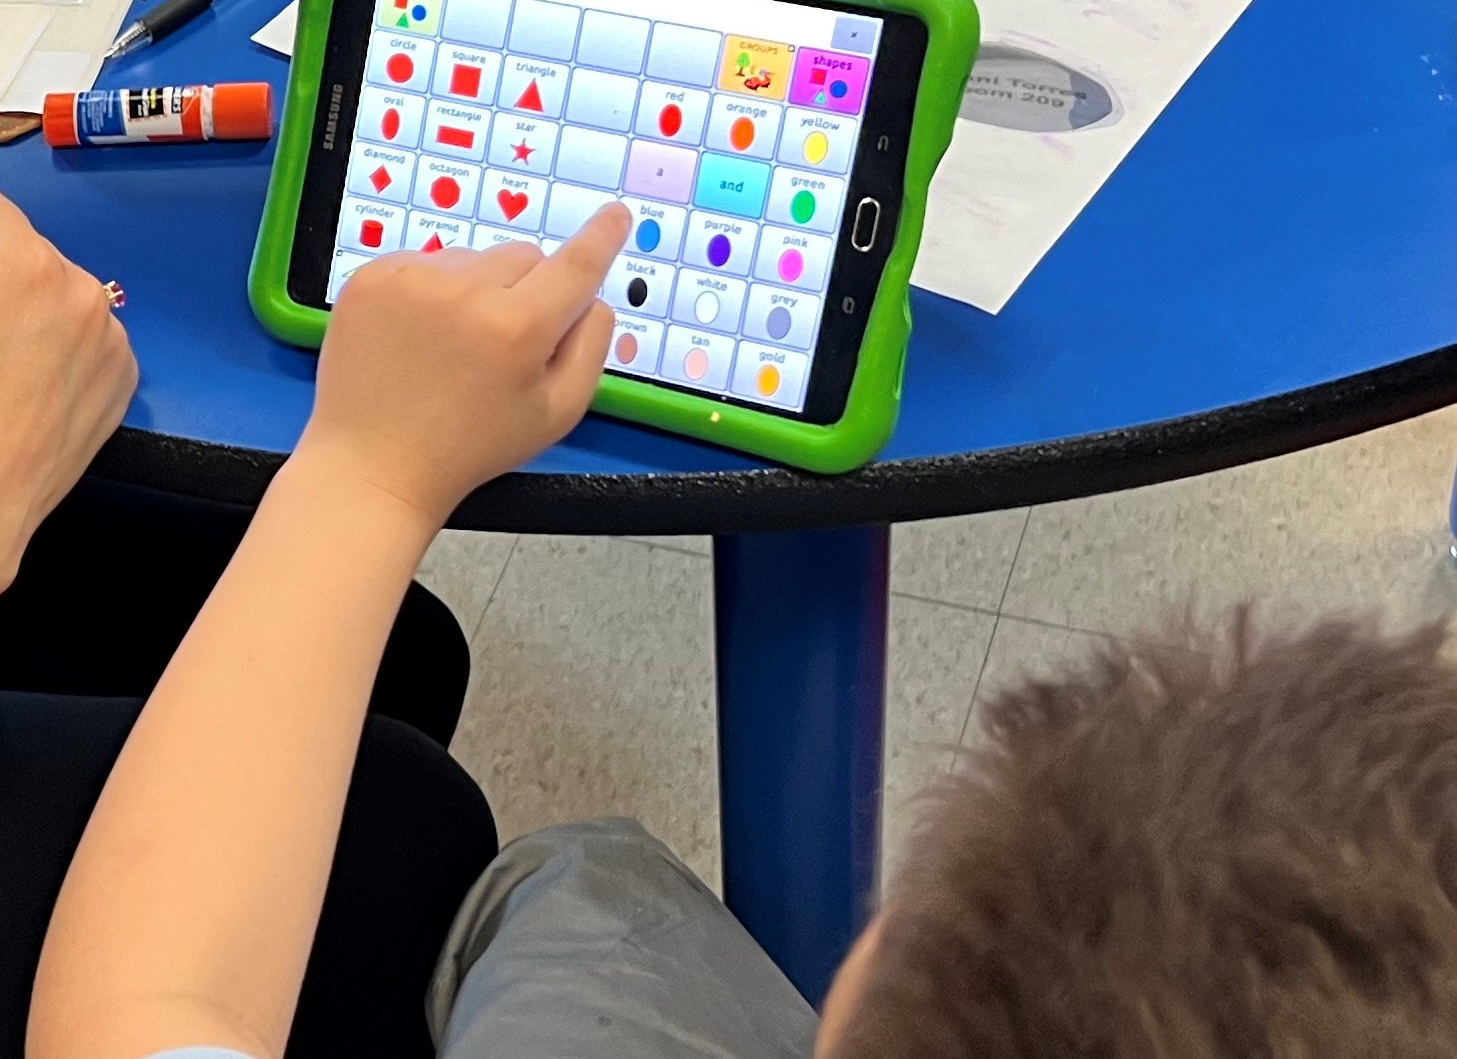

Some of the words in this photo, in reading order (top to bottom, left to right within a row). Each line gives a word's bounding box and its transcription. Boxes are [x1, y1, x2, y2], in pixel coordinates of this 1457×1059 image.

[390, 39, 417, 51] circle
[452, 51, 486, 65] square
[813, 55, 853, 71] shapes
[516, 62, 557, 78] triangle
[383, 95, 404, 107] oval
[665, 91, 685, 102] red
[1020, 92, 1065, 108] 209
[323, 83, 344, 151] SAMSUNG
[436, 105, 482, 122] rectangle
[726, 102, 768, 118] orange
[515, 121, 536, 132] star
[800, 116, 840, 131] yellow
[363, 148, 406, 165] diamond
[429, 162, 470, 178] octagon
[656, 167, 664, 177] a
[501, 175, 530, 190] heart
[719, 178, 745, 193] and
[790, 176, 826, 190] green
[354, 203, 395, 220] cylinder
[639, 204, 665, 219] blue
[419, 218, 460, 234] pyramid
[704, 218, 743, 235] purple
[782, 234, 809, 248] pink
[625, 260, 657, 277] black
[696, 277, 729, 292] white
[770, 293, 799, 308] grey
[690, 335, 710, 347] tan
[758, 351, 786, 366] gold
